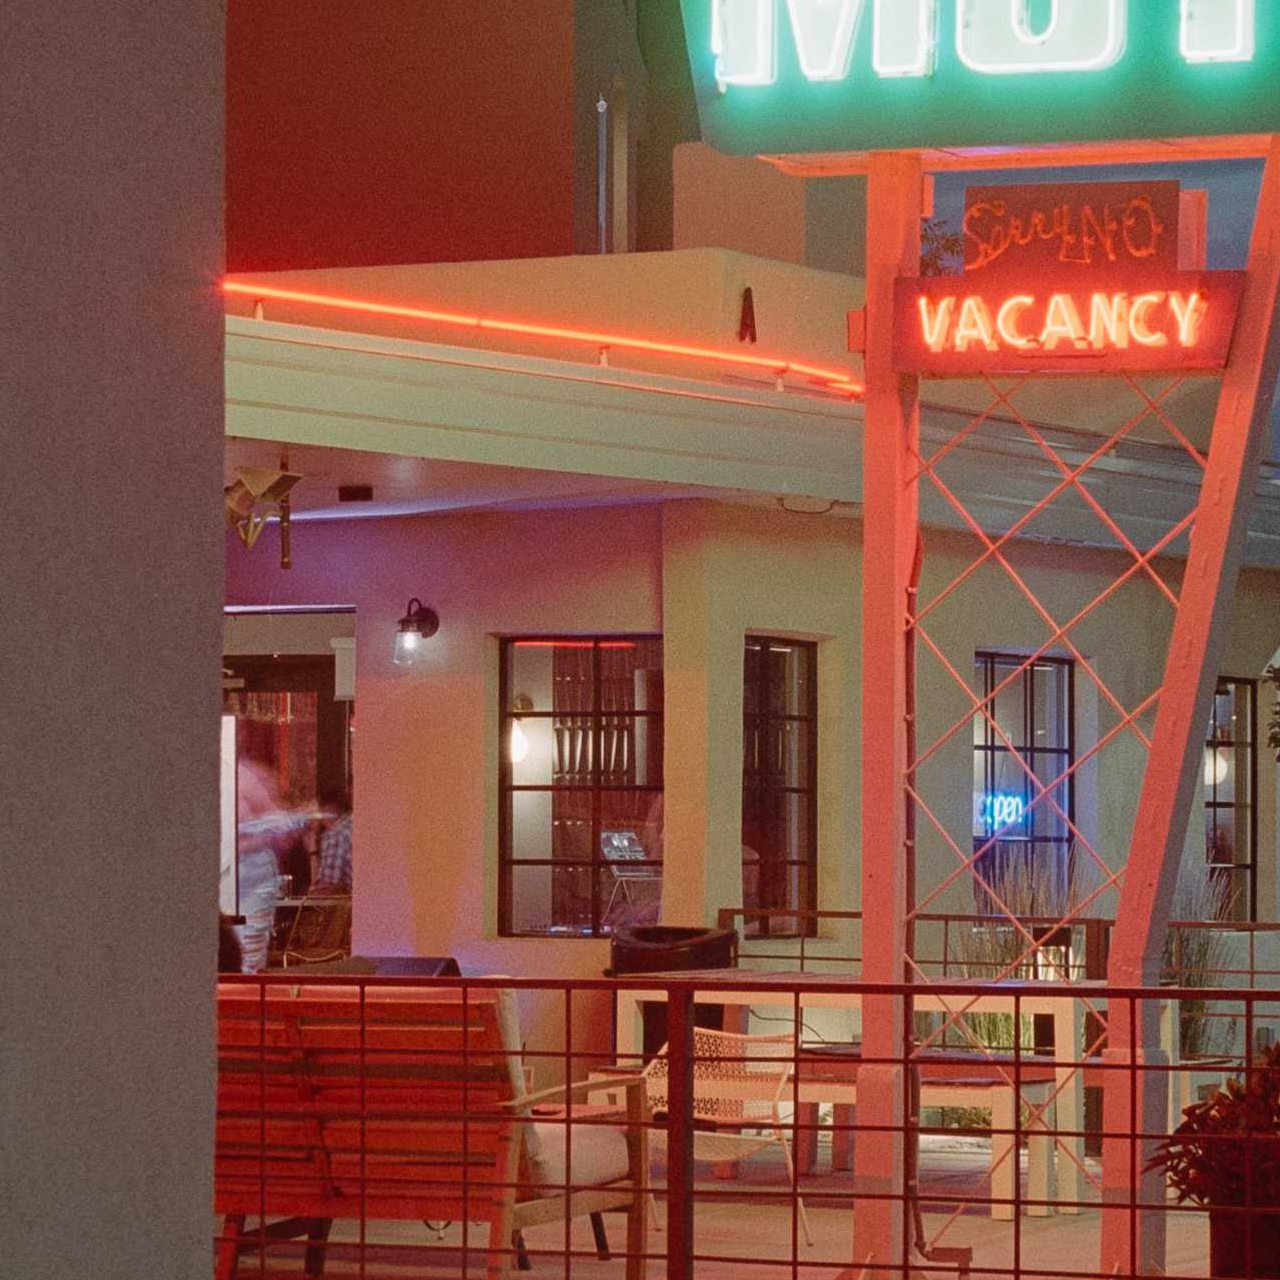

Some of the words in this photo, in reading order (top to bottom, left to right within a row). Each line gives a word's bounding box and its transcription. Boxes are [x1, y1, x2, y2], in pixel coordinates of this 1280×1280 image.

[963, 200, 1074, 271] Sorry
[1081, 195, 1164, 264] NO
[918, 289, 1209, 353] VACANCY
